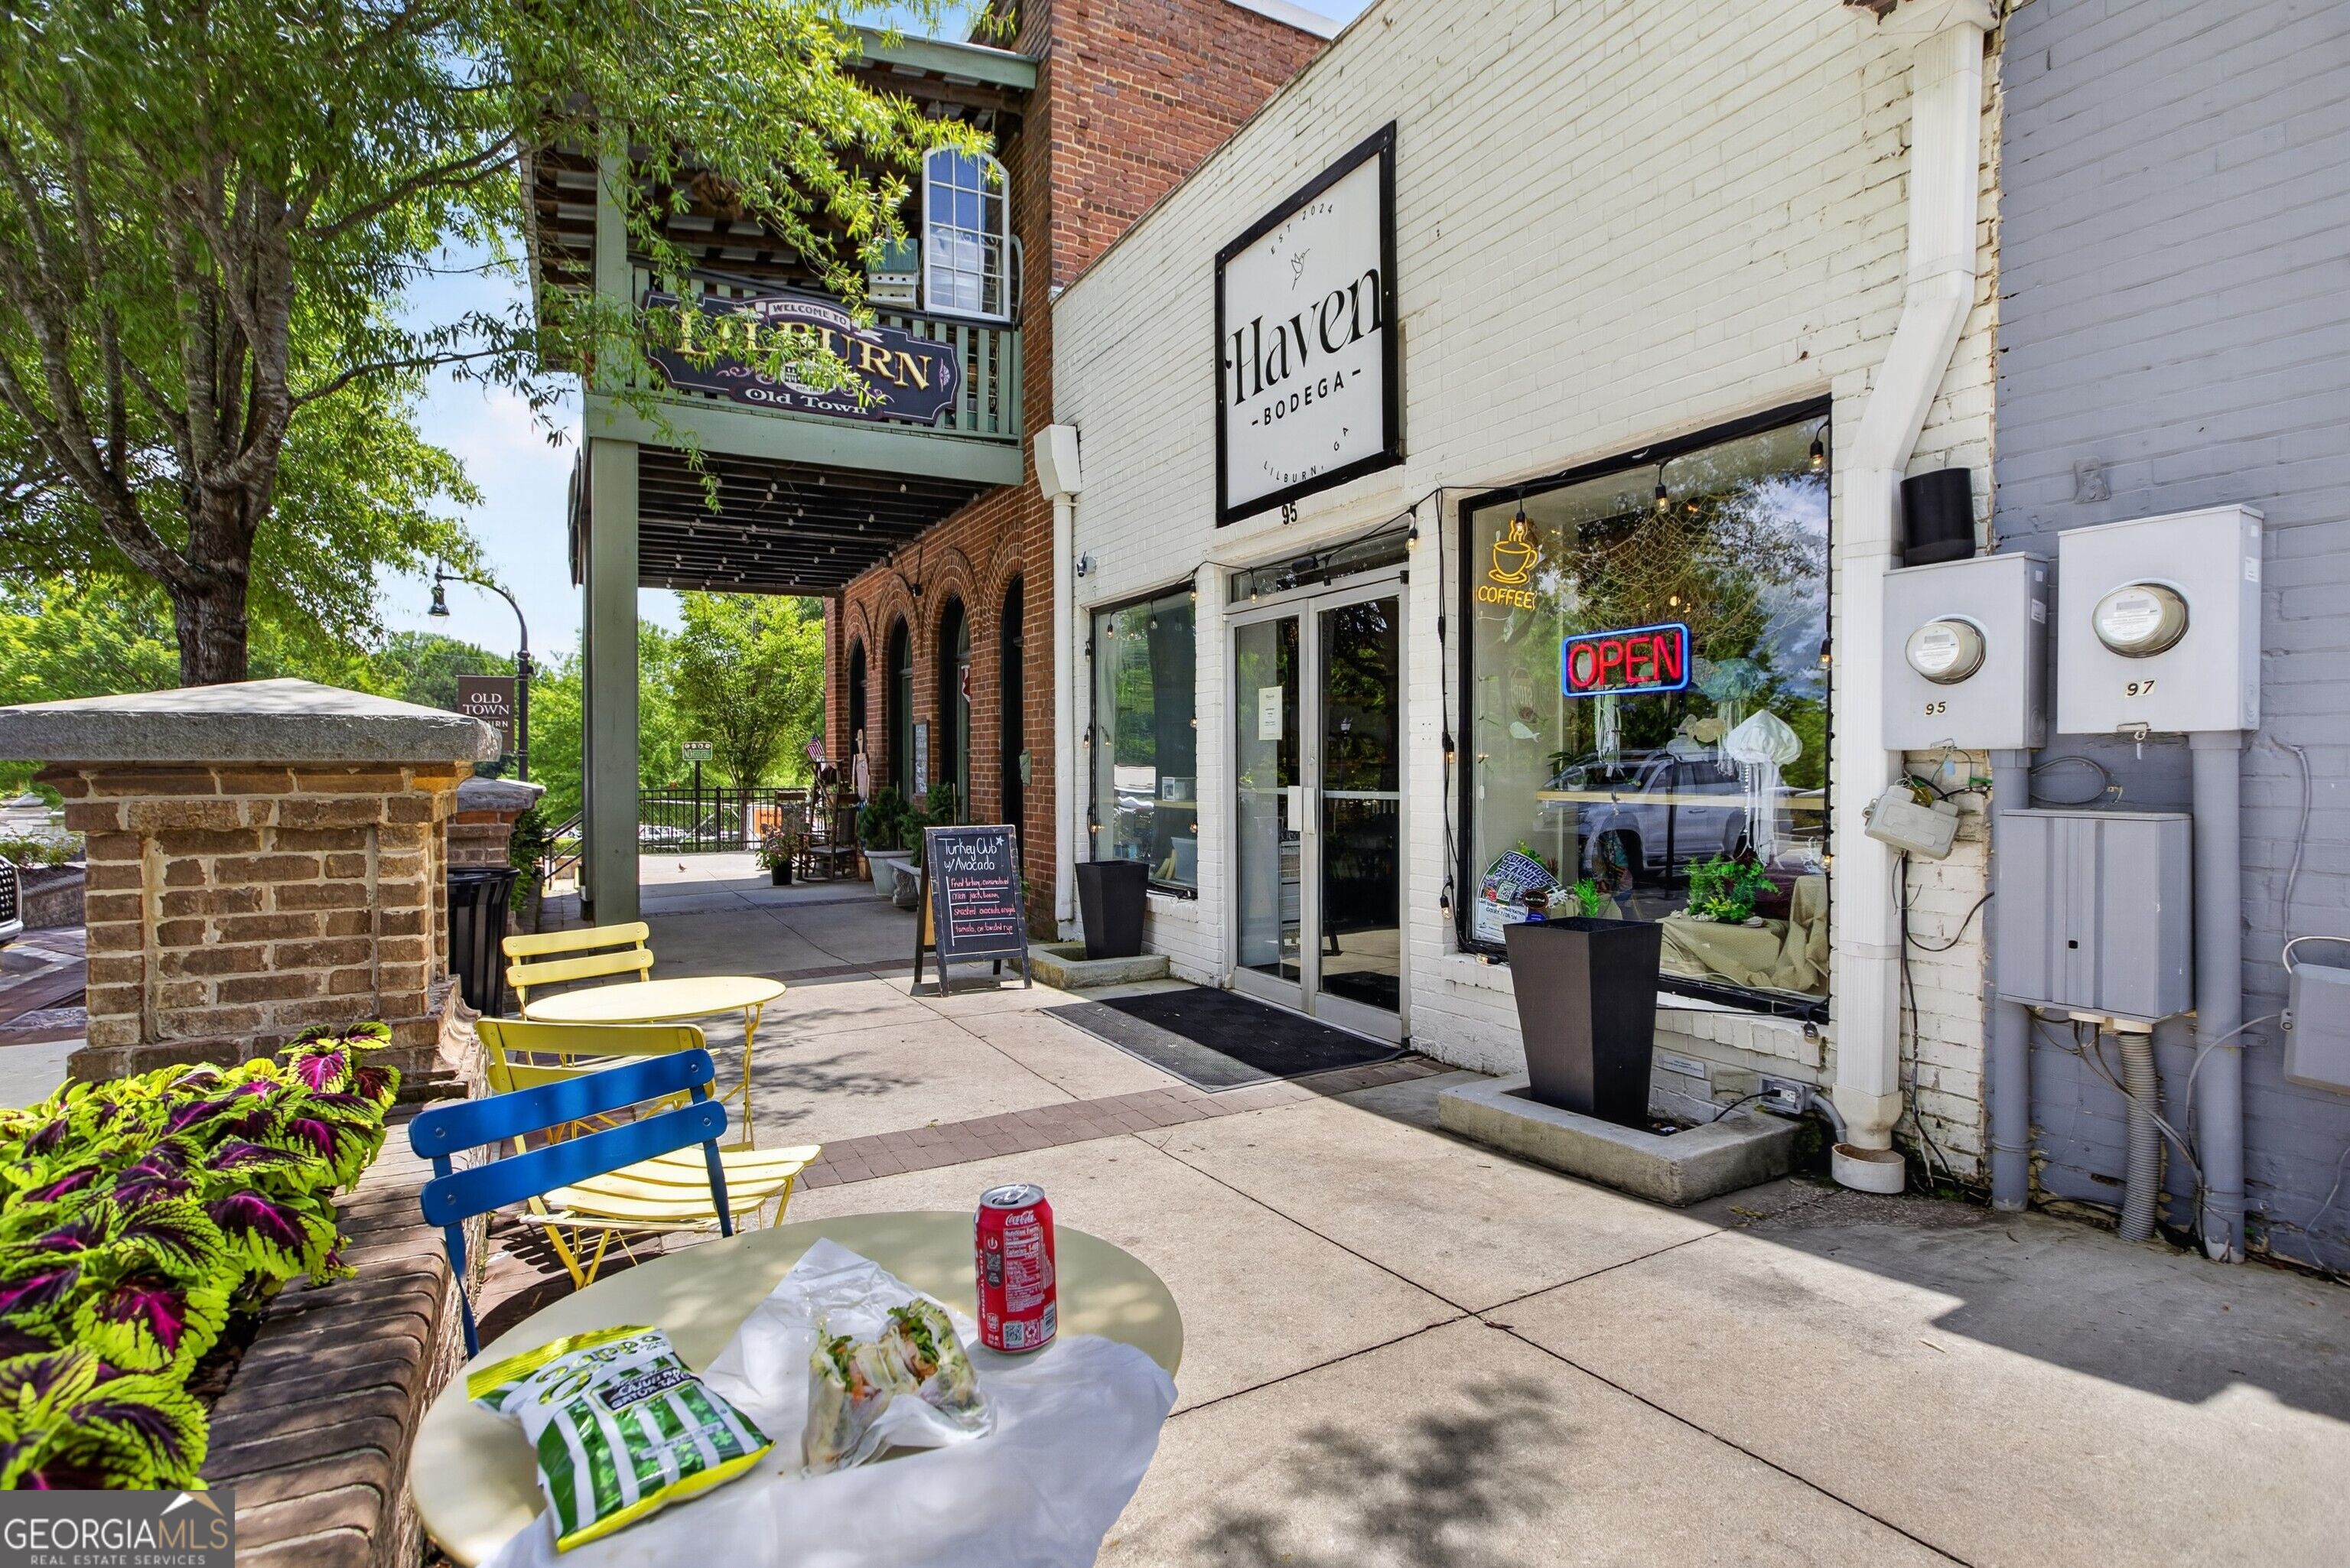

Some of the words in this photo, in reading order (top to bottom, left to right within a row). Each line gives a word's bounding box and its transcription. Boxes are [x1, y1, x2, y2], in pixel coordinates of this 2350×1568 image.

[1270, 223, 1293, 255] EST
[1301, 202, 1334, 222] 2024
[773, 304, 829, 319] WELCOME
[833, 314, 847, 325] TO
[1225, 267, 1383, 407] Haven
[745, 387, 793, 405] Old
[800, 395, 869, 415] Town
[1333, 426, 1349, 452] GA
[1281, 502, 1299, 526] 95
[1477, 585, 1535, 609] COFFEE
[1568, 633, 1682, 688] OPEN
[471, 692, 502, 704] OLD
[2127, 680, 2155, 697] 97
[463, 704, 509, 715] TOWN
[1925, 701, 1946, 715] 95
[937, 838, 975, 862] Turkey
[976, 837, 998, 854] Club
